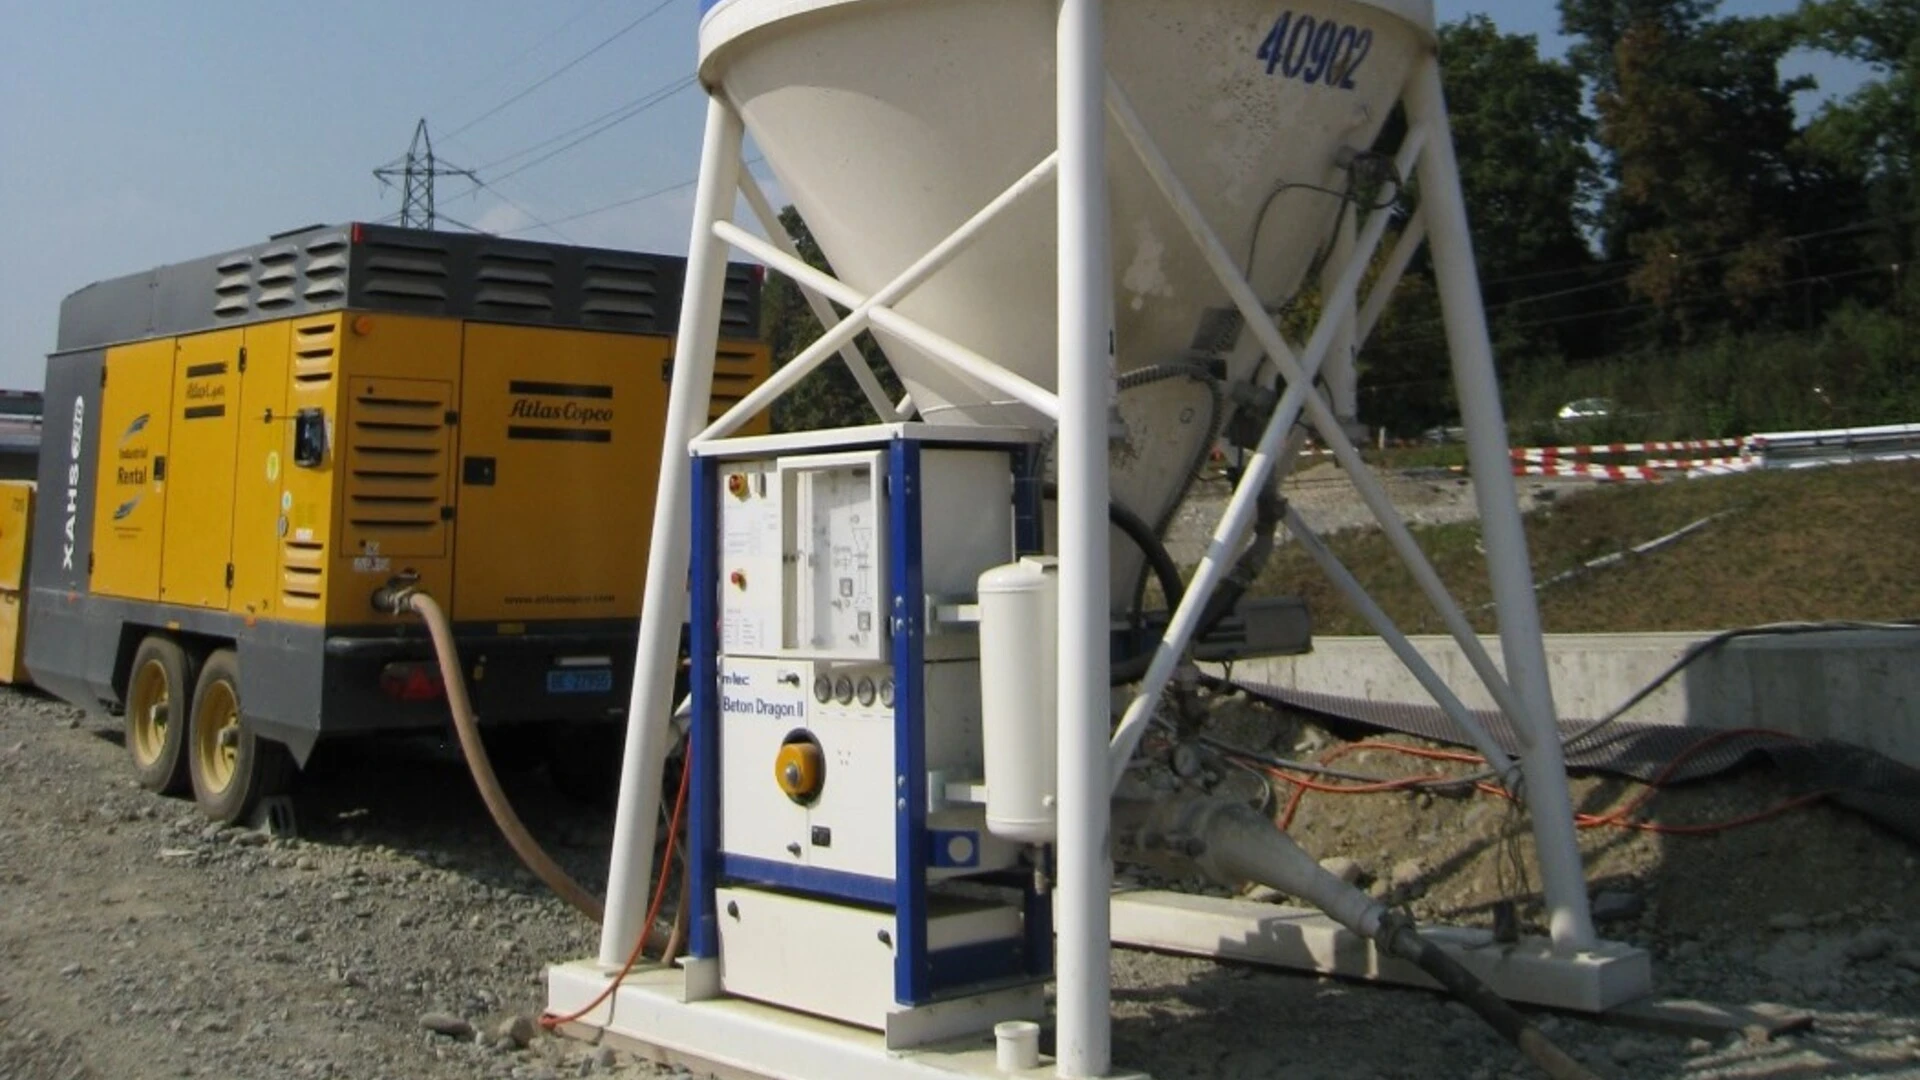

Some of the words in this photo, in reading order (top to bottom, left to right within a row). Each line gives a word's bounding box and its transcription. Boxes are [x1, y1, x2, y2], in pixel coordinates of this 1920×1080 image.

[1256, 10, 1373, 90] 40902
[117, 465, 147, 485] Rental
[723, 696, 754, 713] Beton
[755, 698, 795, 720] Dragon
